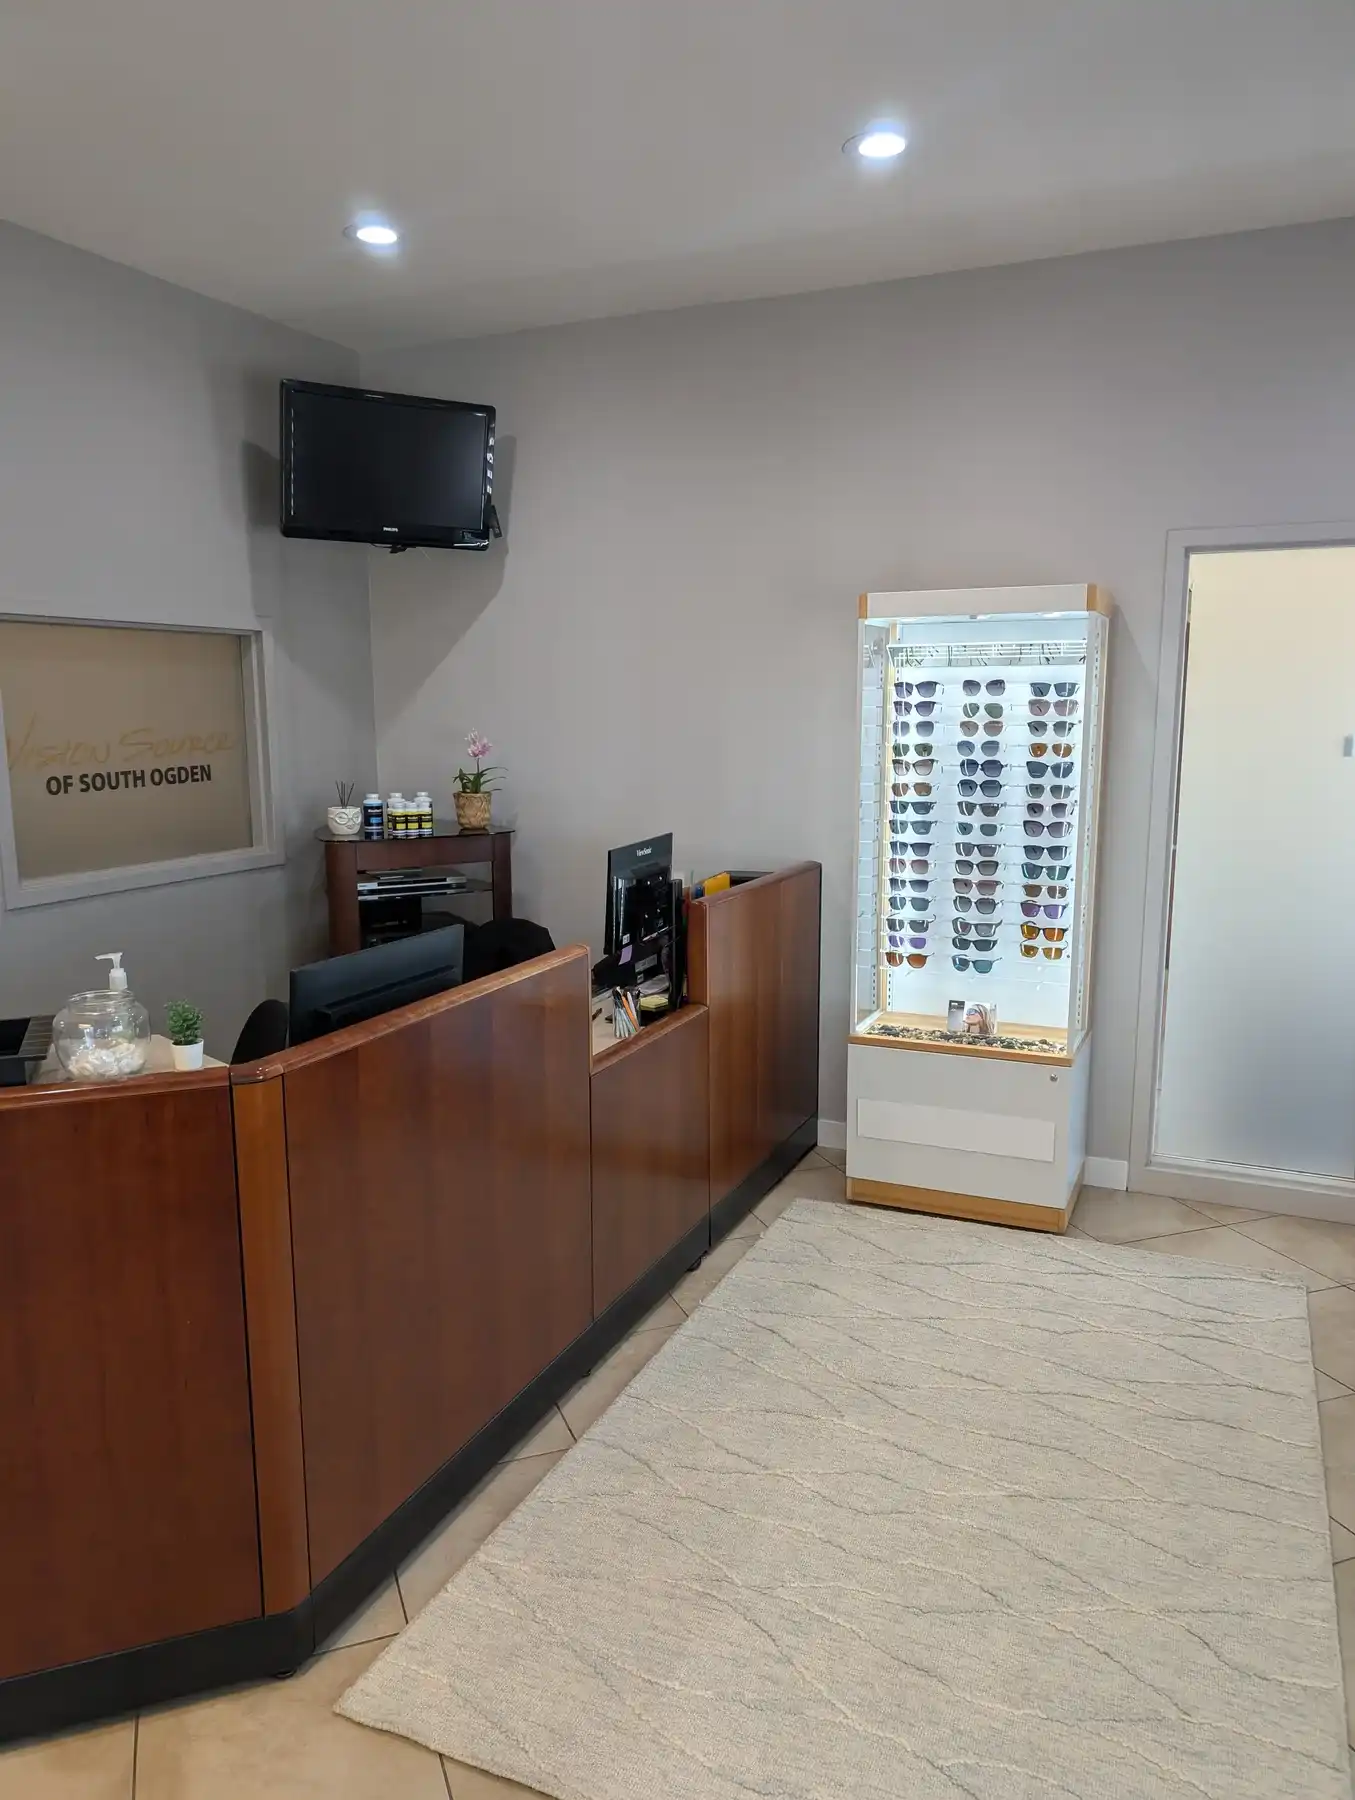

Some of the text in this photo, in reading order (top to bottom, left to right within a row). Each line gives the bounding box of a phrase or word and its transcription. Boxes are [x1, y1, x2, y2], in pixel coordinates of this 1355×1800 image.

[46, 764, 212, 796] OF SOUTH OGDEN
